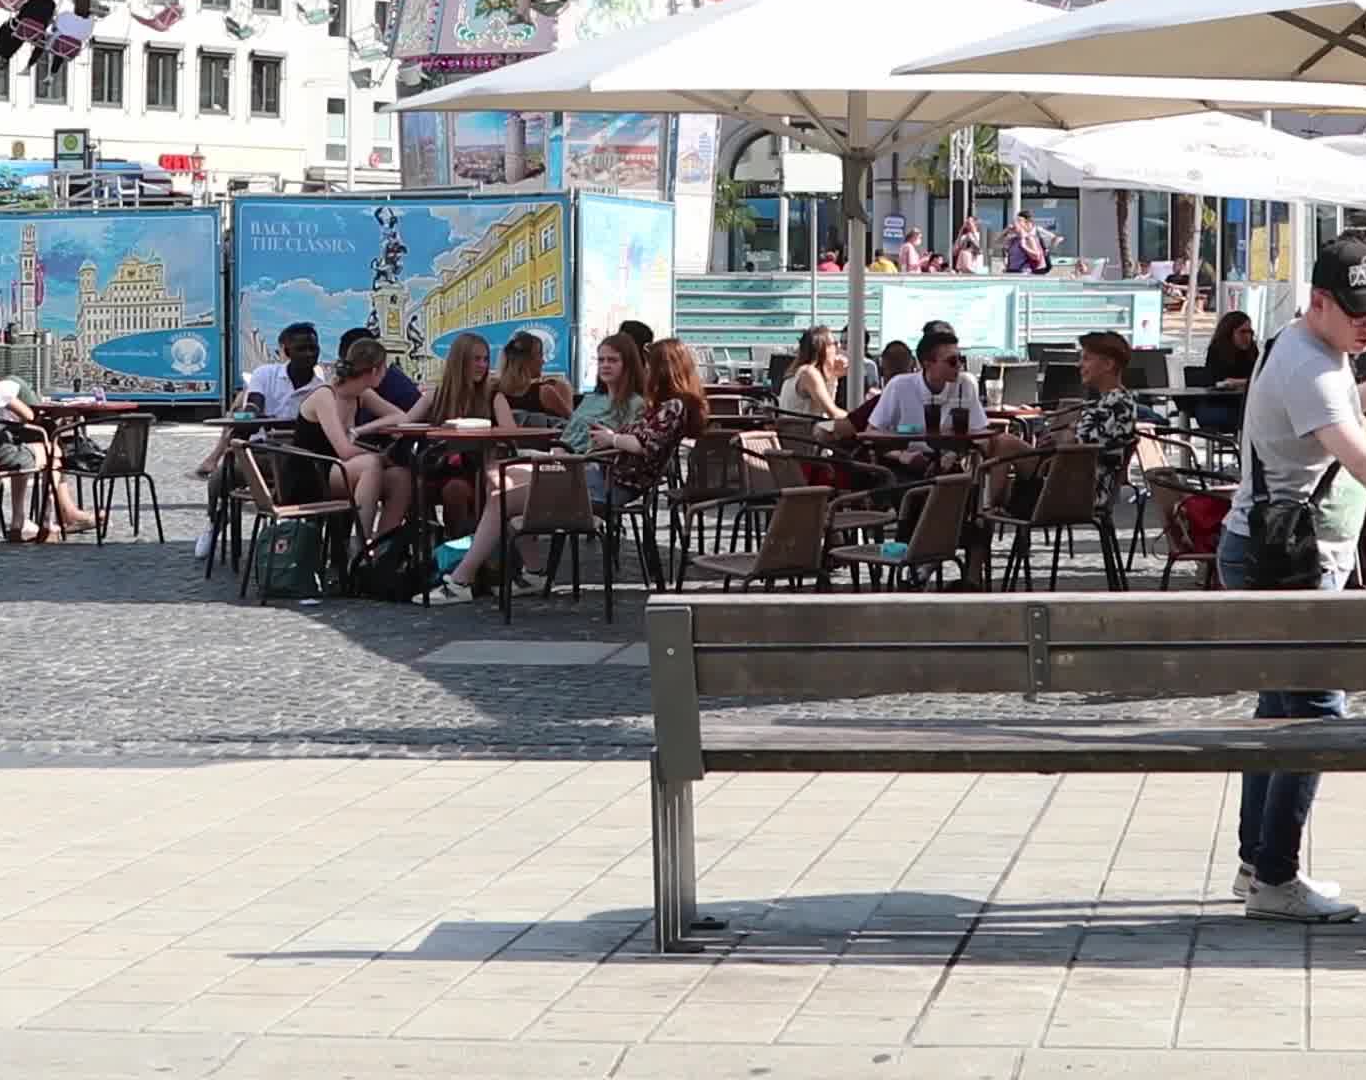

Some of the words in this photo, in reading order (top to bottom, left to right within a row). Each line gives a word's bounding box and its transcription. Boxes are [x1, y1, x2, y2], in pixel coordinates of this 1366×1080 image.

[251, 222, 291, 235] BACK
[298, 223, 320, 235] TO
[251, 236, 283, 251] THE
[285, 238, 356, 253] CLASSICS
